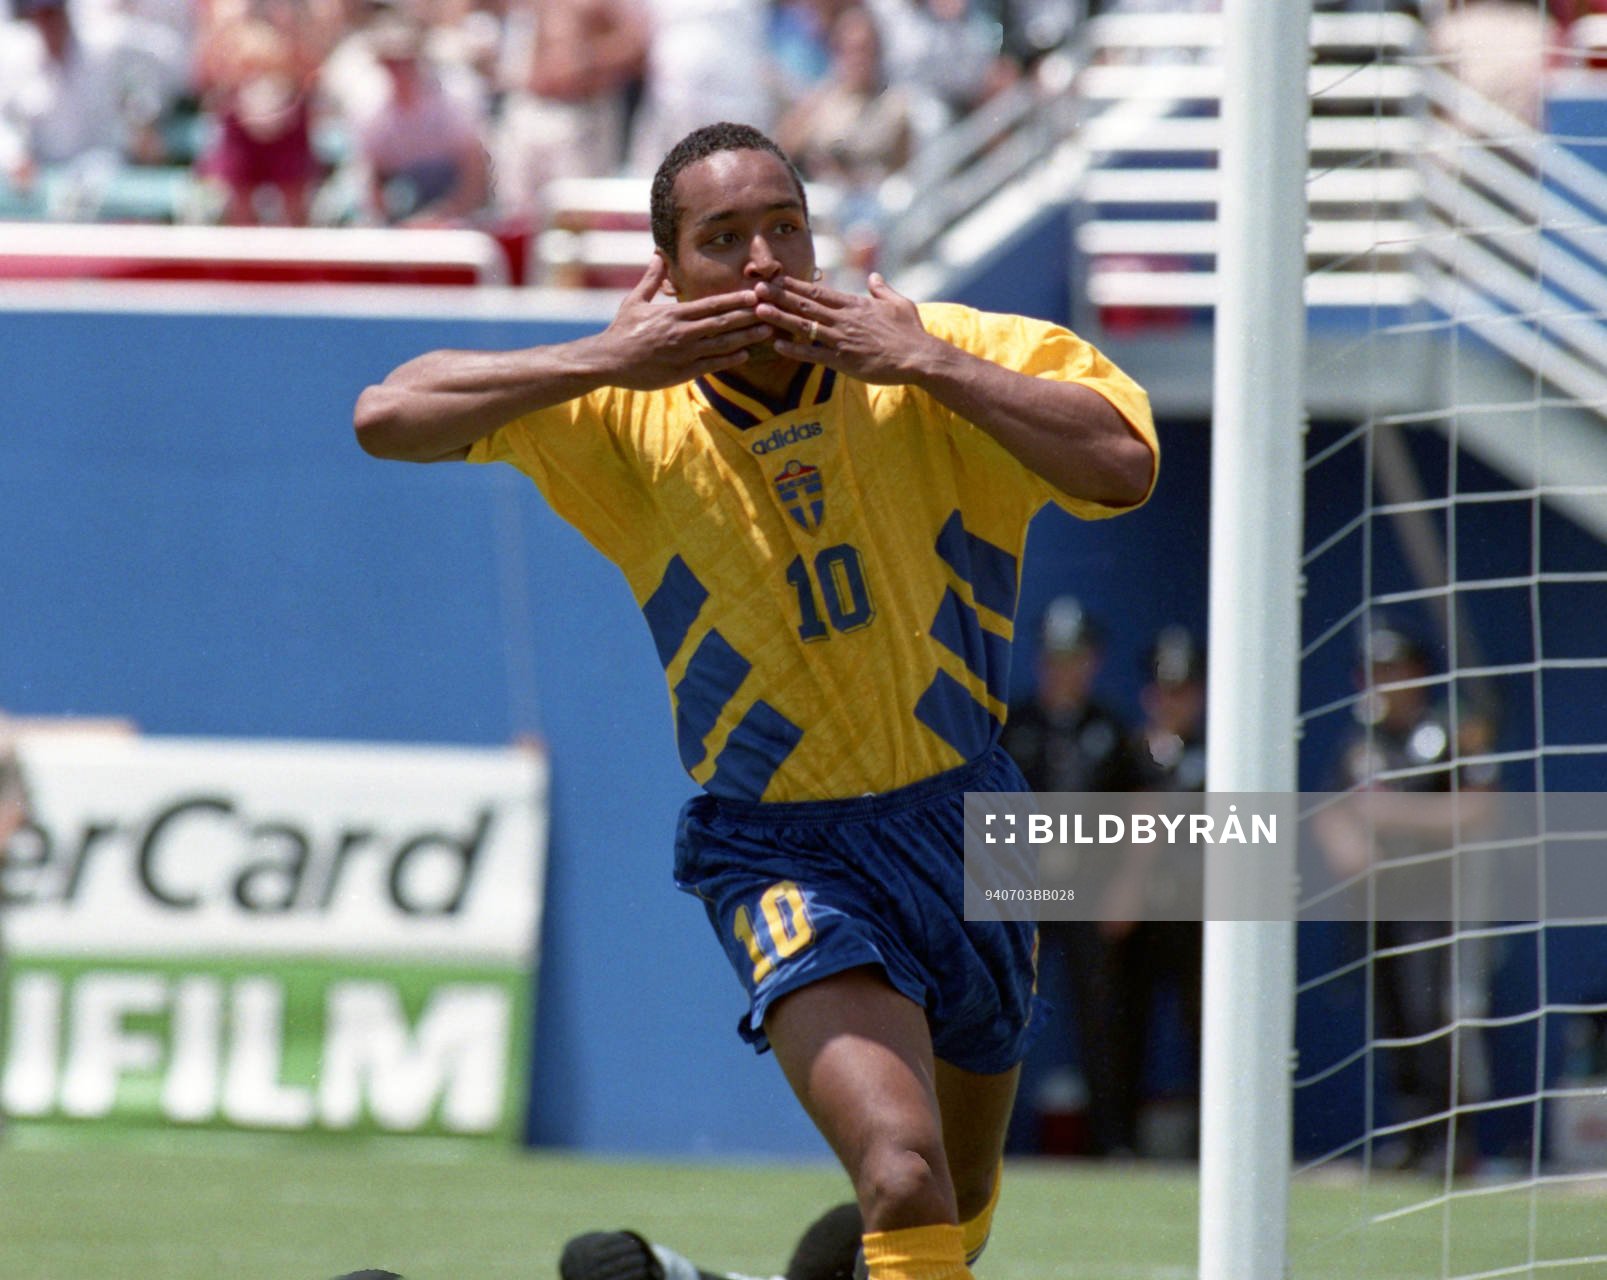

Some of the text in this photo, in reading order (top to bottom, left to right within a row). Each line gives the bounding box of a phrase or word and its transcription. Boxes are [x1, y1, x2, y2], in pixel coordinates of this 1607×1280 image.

[751, 421, 823, 455] adidas
[786, 543, 876, 643] 10
[733, 880, 816, 984] 10
[2, 970, 510, 1132] IFILM
